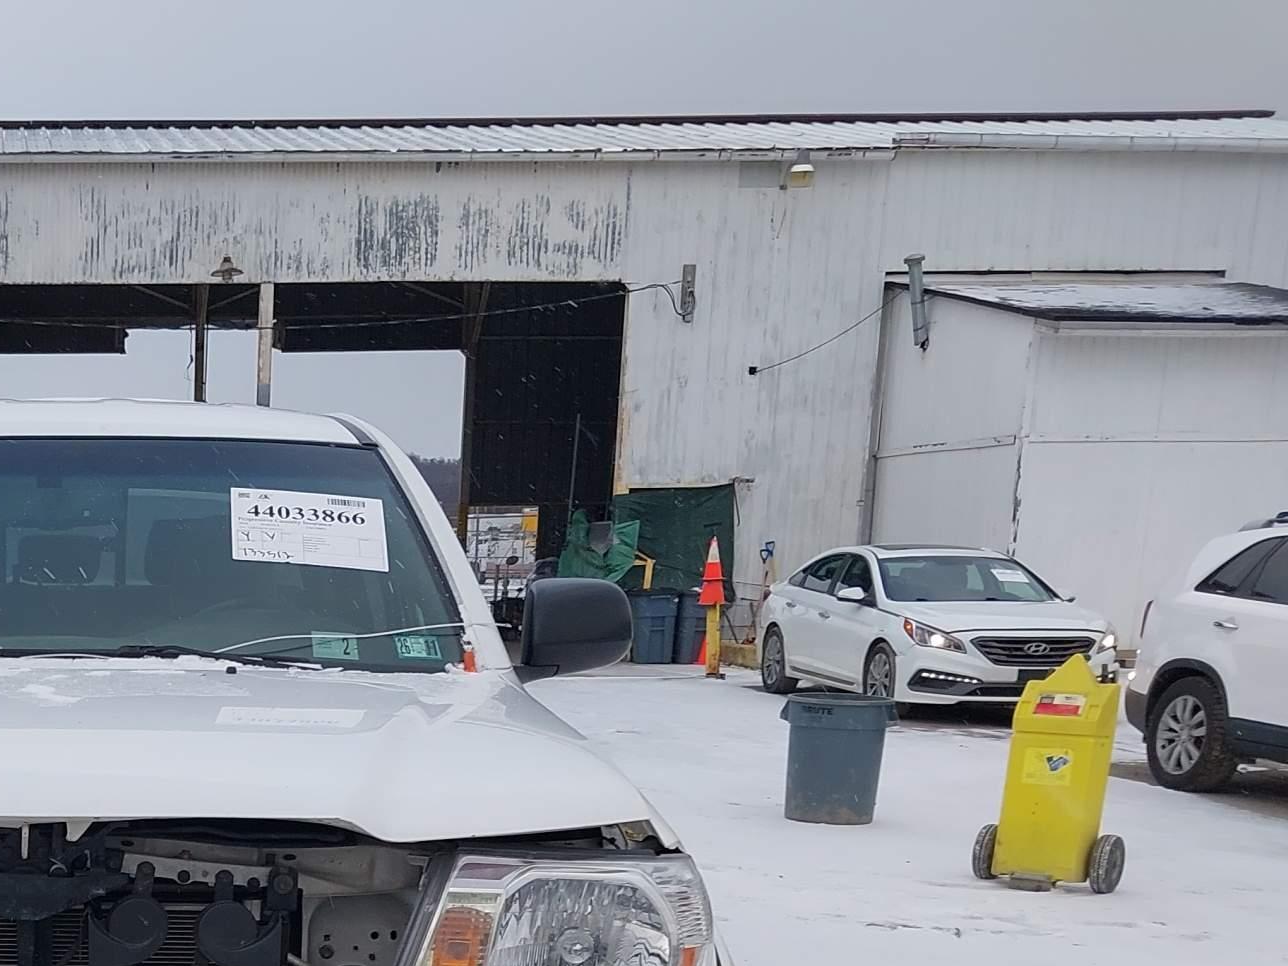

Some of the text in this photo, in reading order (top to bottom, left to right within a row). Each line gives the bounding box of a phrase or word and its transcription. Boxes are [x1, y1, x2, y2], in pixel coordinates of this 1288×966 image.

[247, 504, 366, 525] 44033866
[342, 638, 351, 656] 2
[397, 638, 411, 655] 26
